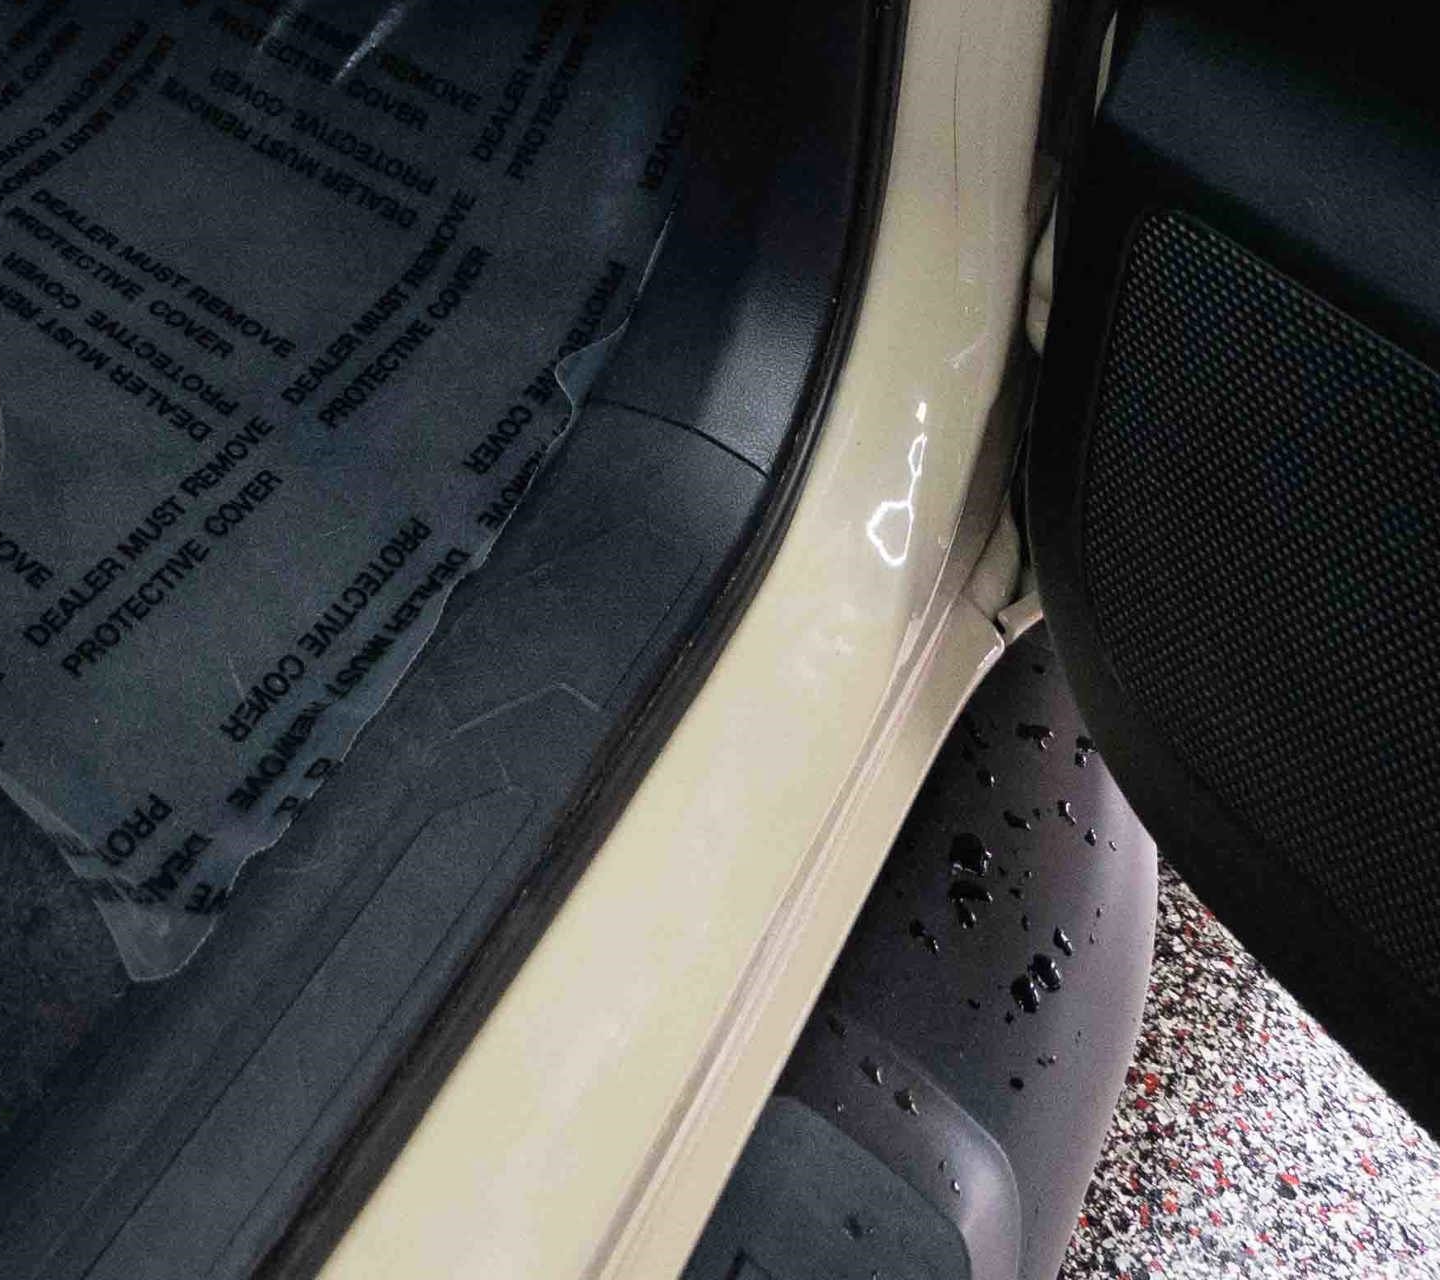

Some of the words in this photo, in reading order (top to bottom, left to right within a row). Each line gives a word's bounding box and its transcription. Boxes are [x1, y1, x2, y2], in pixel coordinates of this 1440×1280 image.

[159, 76, 253, 143] REMOVE
[209, 68, 286, 117] COVER
[346, 78, 429, 132] COVER
[470, 68, 534, 163] DEALER
[250, 134, 321, 179] MUST
[290, 109, 438, 196] PROTECTIVE
[320, 167, 418, 230] DEALER
[1, 251, 81, 310] COVER
[5, 206, 145, 297] PROTECTIVE
[149, 300, 234, 359] COVER
[30, 189, 120, 251] DEALER
[117, 245, 191, 289] MUST
[186, 285, 297, 359] REMOVE
[280, 333, 363, 406] DEALER
[352, 283, 409, 336] MUST
[400, 189, 477, 289] REMOVE
[36, 318, 111, 371] MUST
[84, 310, 240, 417] PROTECTIVE
[317, 319, 435, 430] PROTECTIVE
[426, 245, 493, 320] COVER
[109, 364, 213, 443] DEALER
[461, 404, 533, 476] COVER
[22, 557, 126, 649] DEALER
[116, 495, 186, 561] MUST
[179, 416, 275, 498] REMOVE
[60, 539, 211, 679] PROTECTIVE
[204, 469, 283, 538] COVER
[297, 516, 432, 658] PROTECTIVE
[383, 548, 471, 634] DEALER
[219, 654, 305, 743] COVER
[325, 634, 394, 699] MUST
